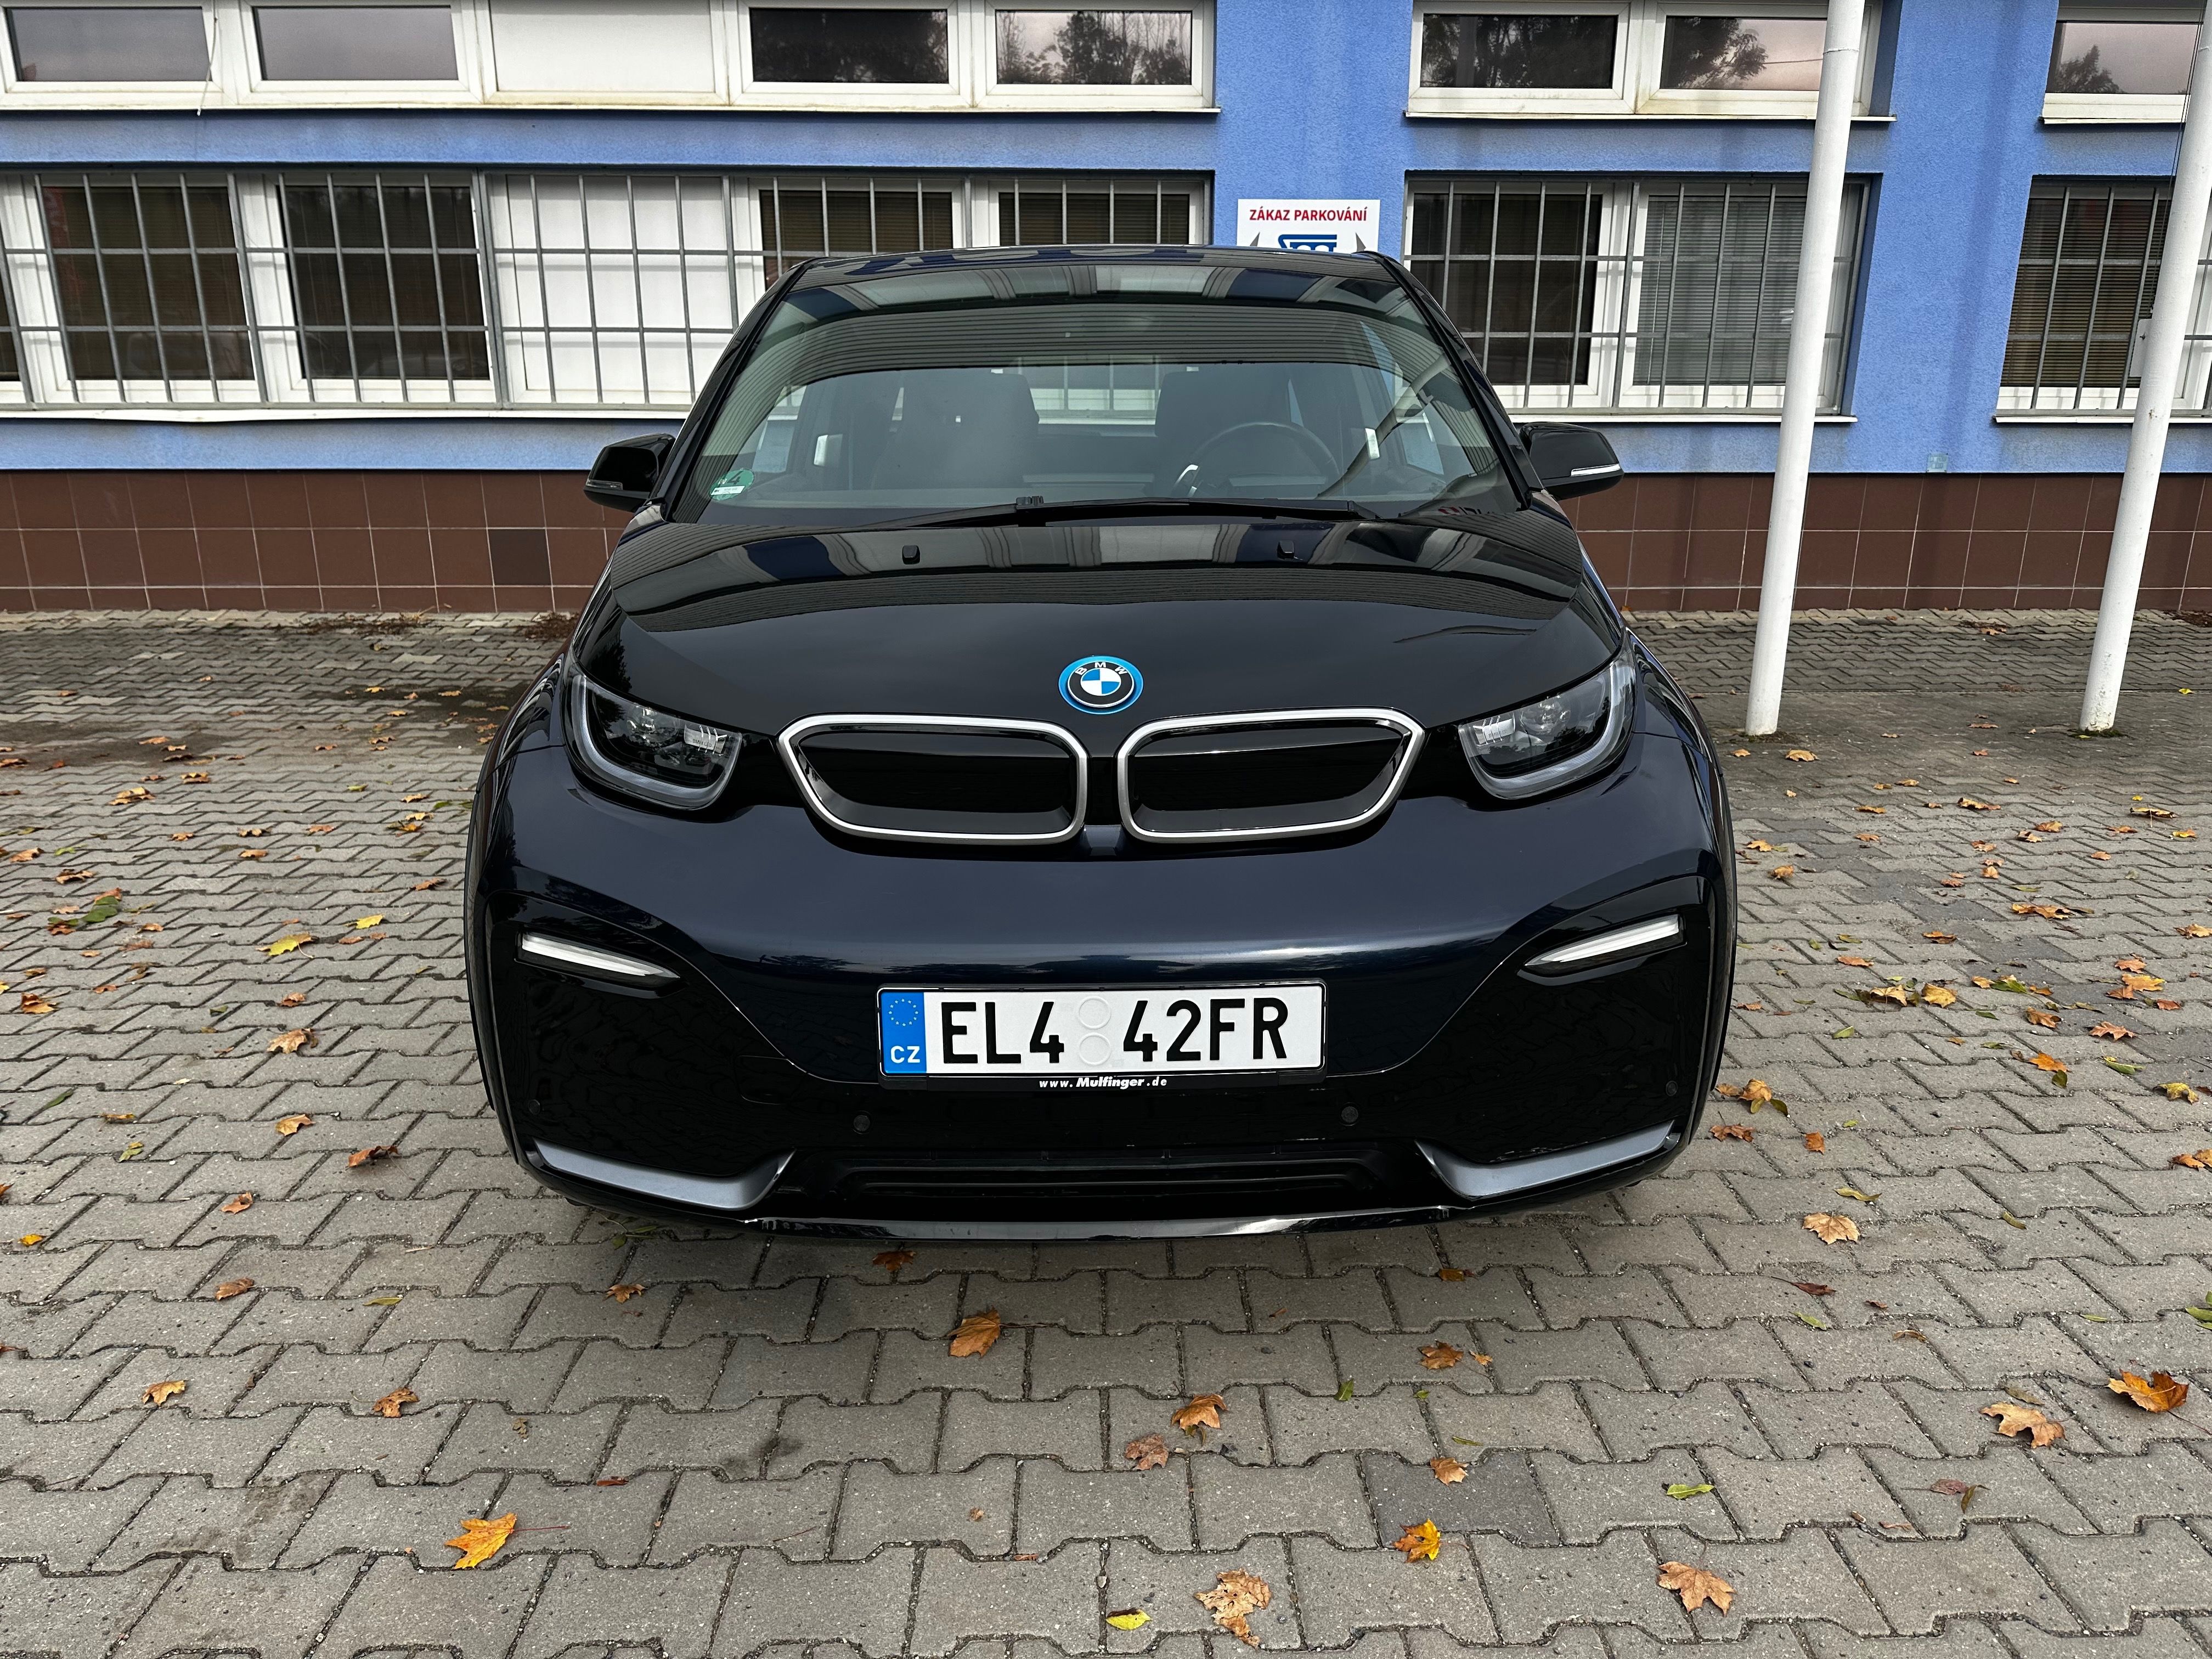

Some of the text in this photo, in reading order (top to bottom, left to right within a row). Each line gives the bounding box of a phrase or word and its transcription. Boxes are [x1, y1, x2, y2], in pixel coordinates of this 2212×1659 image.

[1249, 206, 1368, 221] ZÁKAZ PARKOVÁNÍ
[727, 470, 744, 485] 4
[1074, 662, 1128, 675] BMW
[941, 997, 1288, 1064] EL4 42FR
[890, 1045, 921, 1063] CZ
